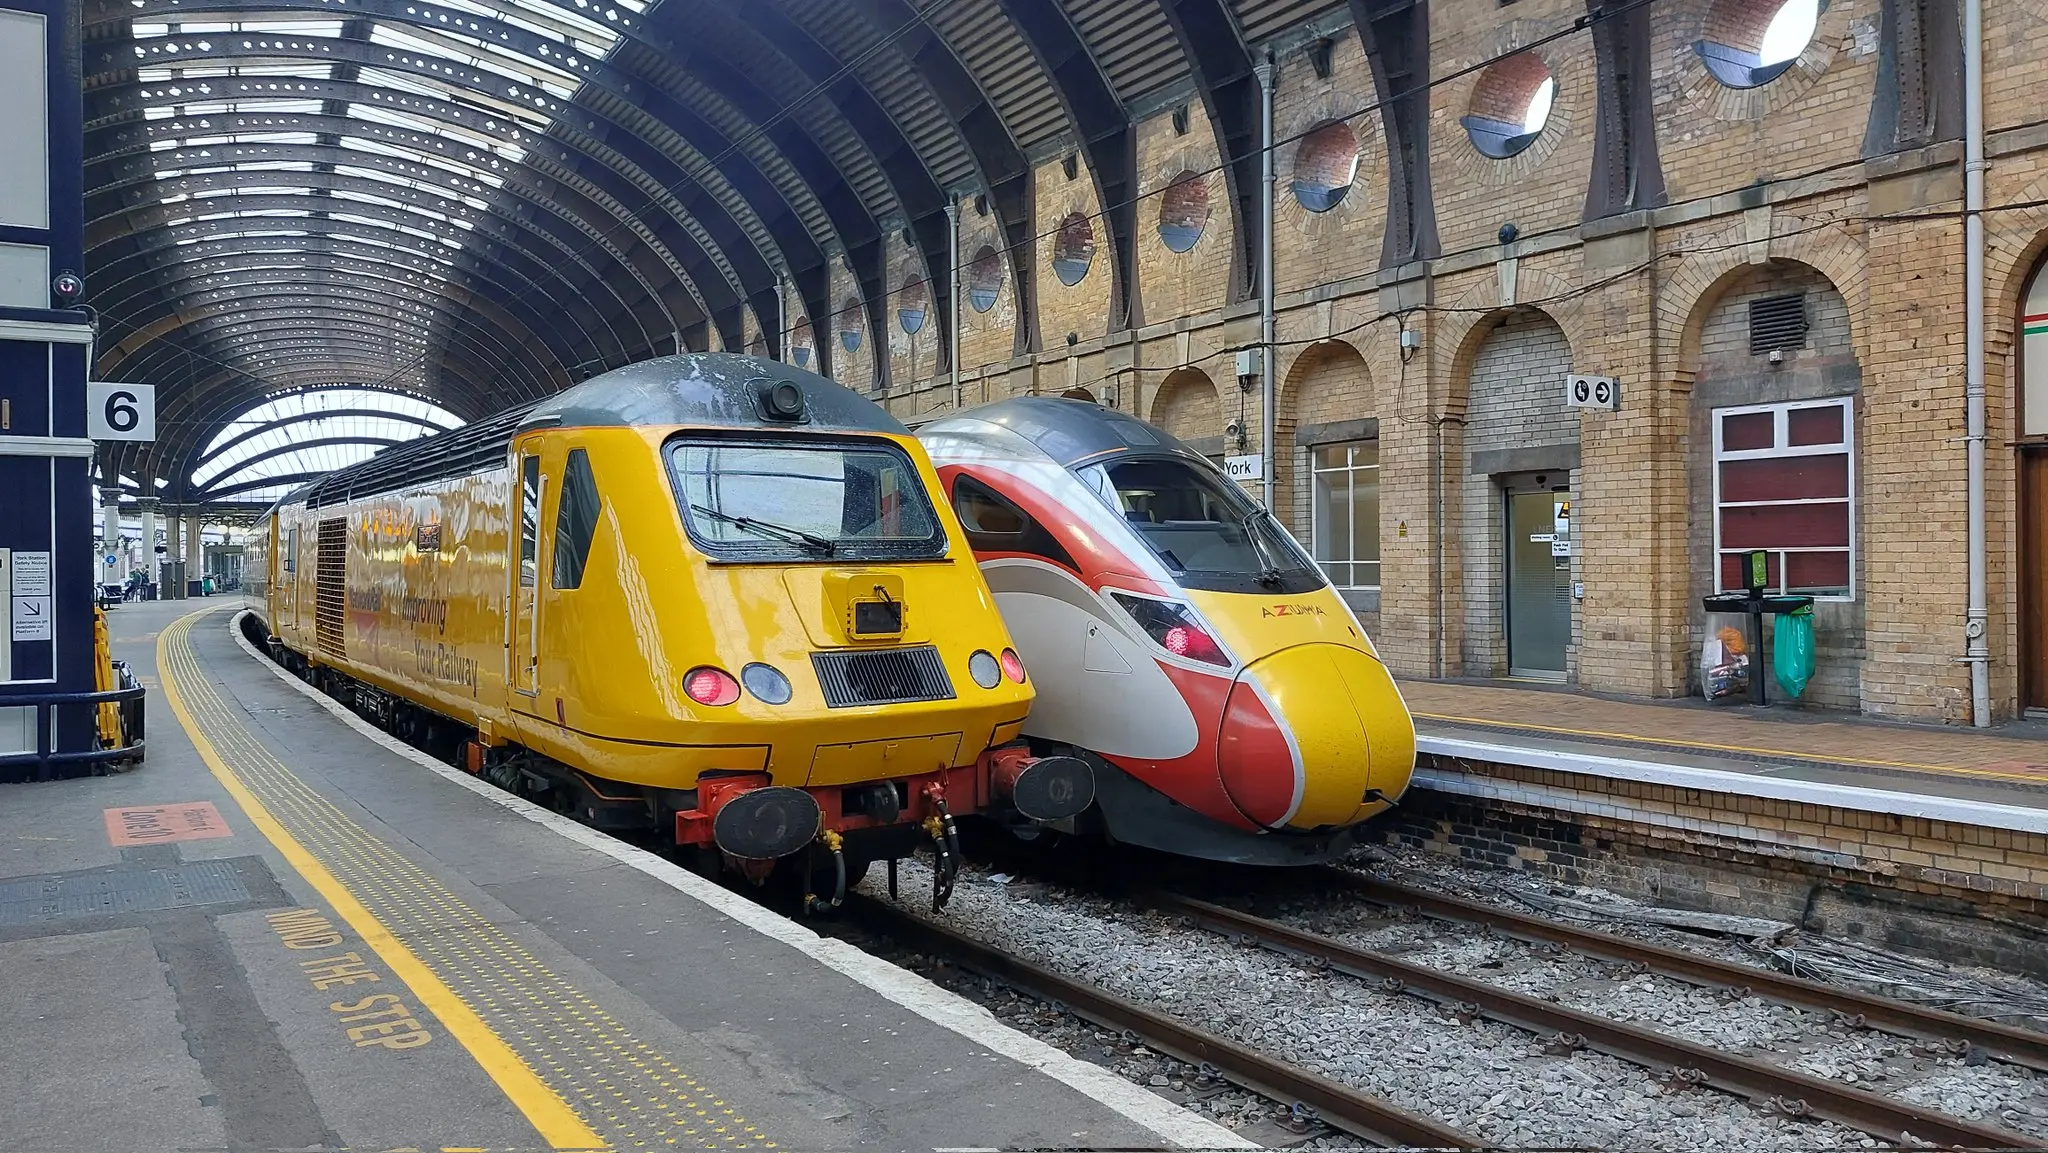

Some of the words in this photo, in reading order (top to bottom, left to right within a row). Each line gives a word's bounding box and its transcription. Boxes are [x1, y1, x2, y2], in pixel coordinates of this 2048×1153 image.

[105, 391, 139, 432] 6
[1225, 460, 1251, 475] York
[402, 596, 446, 635] Improving
[1262, 604, 1327, 618] AZUMA
[415, 639, 435, 675] Your
[438, 643, 478, 698] Railway
[121, 809, 166, 830] Zone
[127, 828, 176, 838] 10
[265, 908, 344, 950] MIND
[299, 951, 381, 991] THE
[329, 993, 433, 1049] STEP
